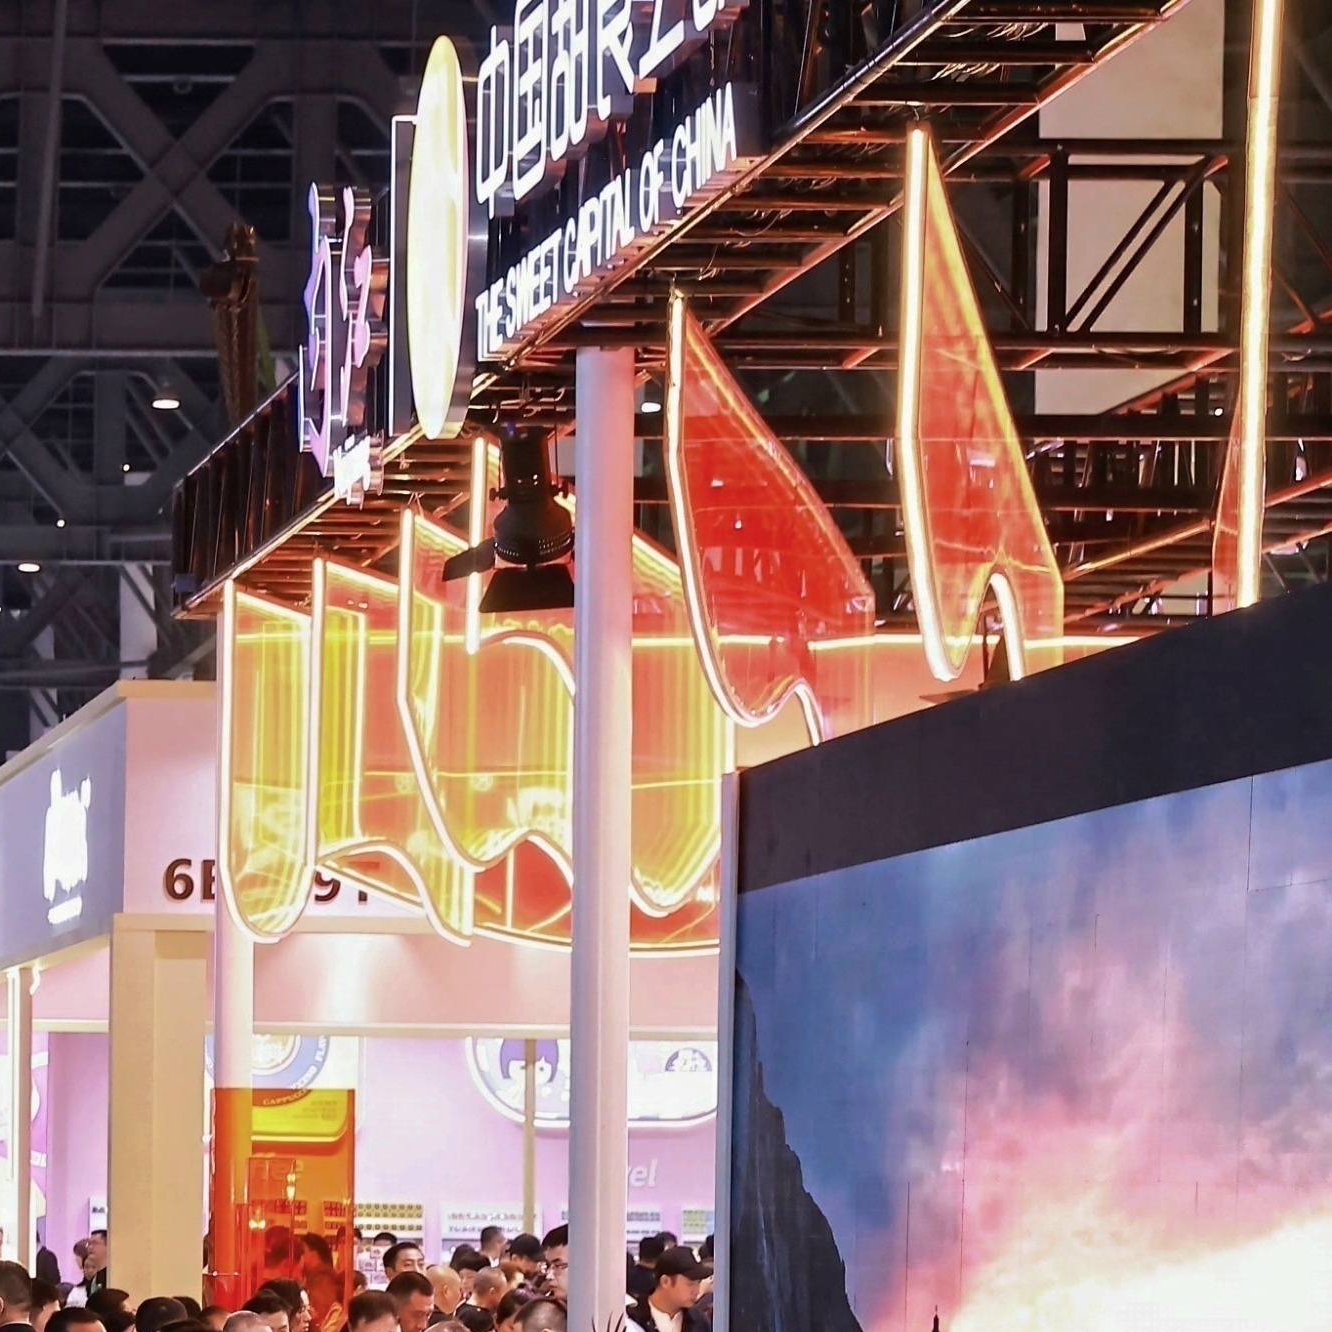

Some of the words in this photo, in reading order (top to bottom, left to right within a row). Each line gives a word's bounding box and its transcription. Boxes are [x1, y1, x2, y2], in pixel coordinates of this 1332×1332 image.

[475, 275, 504, 361] THE
[504, 228, 563, 340] SWEET
[562, 168, 636, 293] CAPITAL
[638, 138, 665, 236] OF
[670, 82, 737, 209] CHINA
